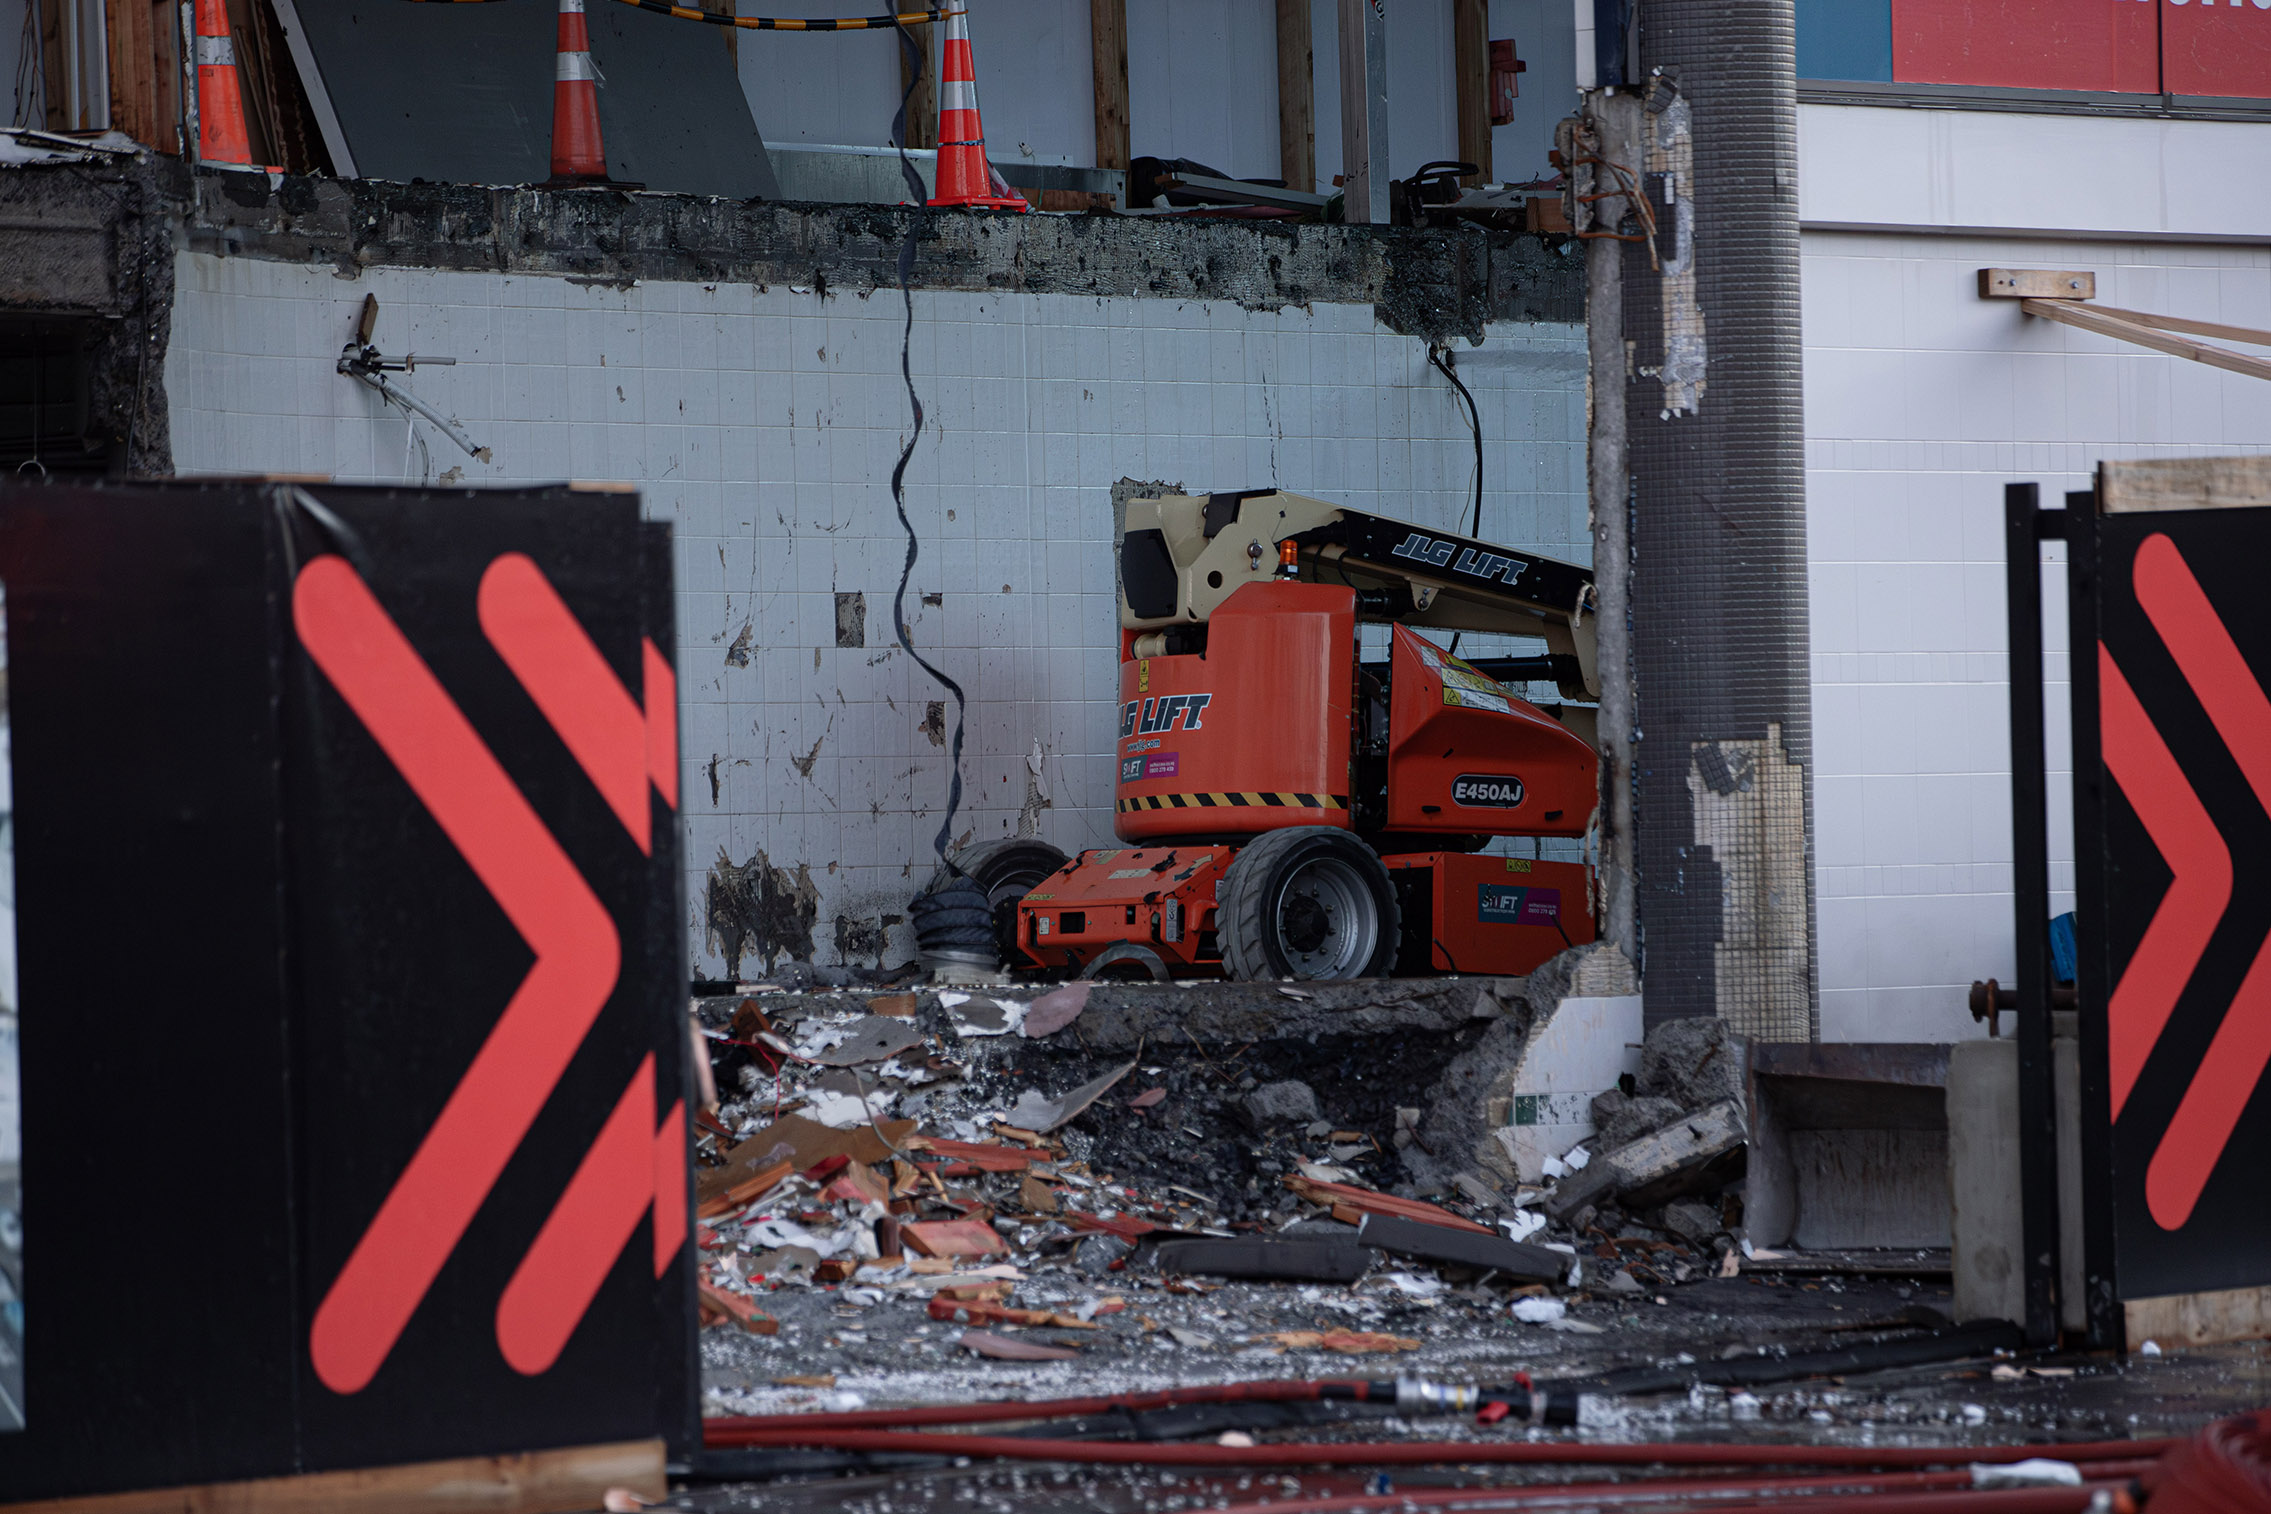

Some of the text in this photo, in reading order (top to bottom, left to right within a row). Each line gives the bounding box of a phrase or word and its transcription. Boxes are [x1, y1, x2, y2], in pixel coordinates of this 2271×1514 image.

[1392, 533, 1528, 585] JLG LIFT
[1118, 693, 1213, 740] LG LIFT
[1455, 783, 1522, 801] E450AJ
